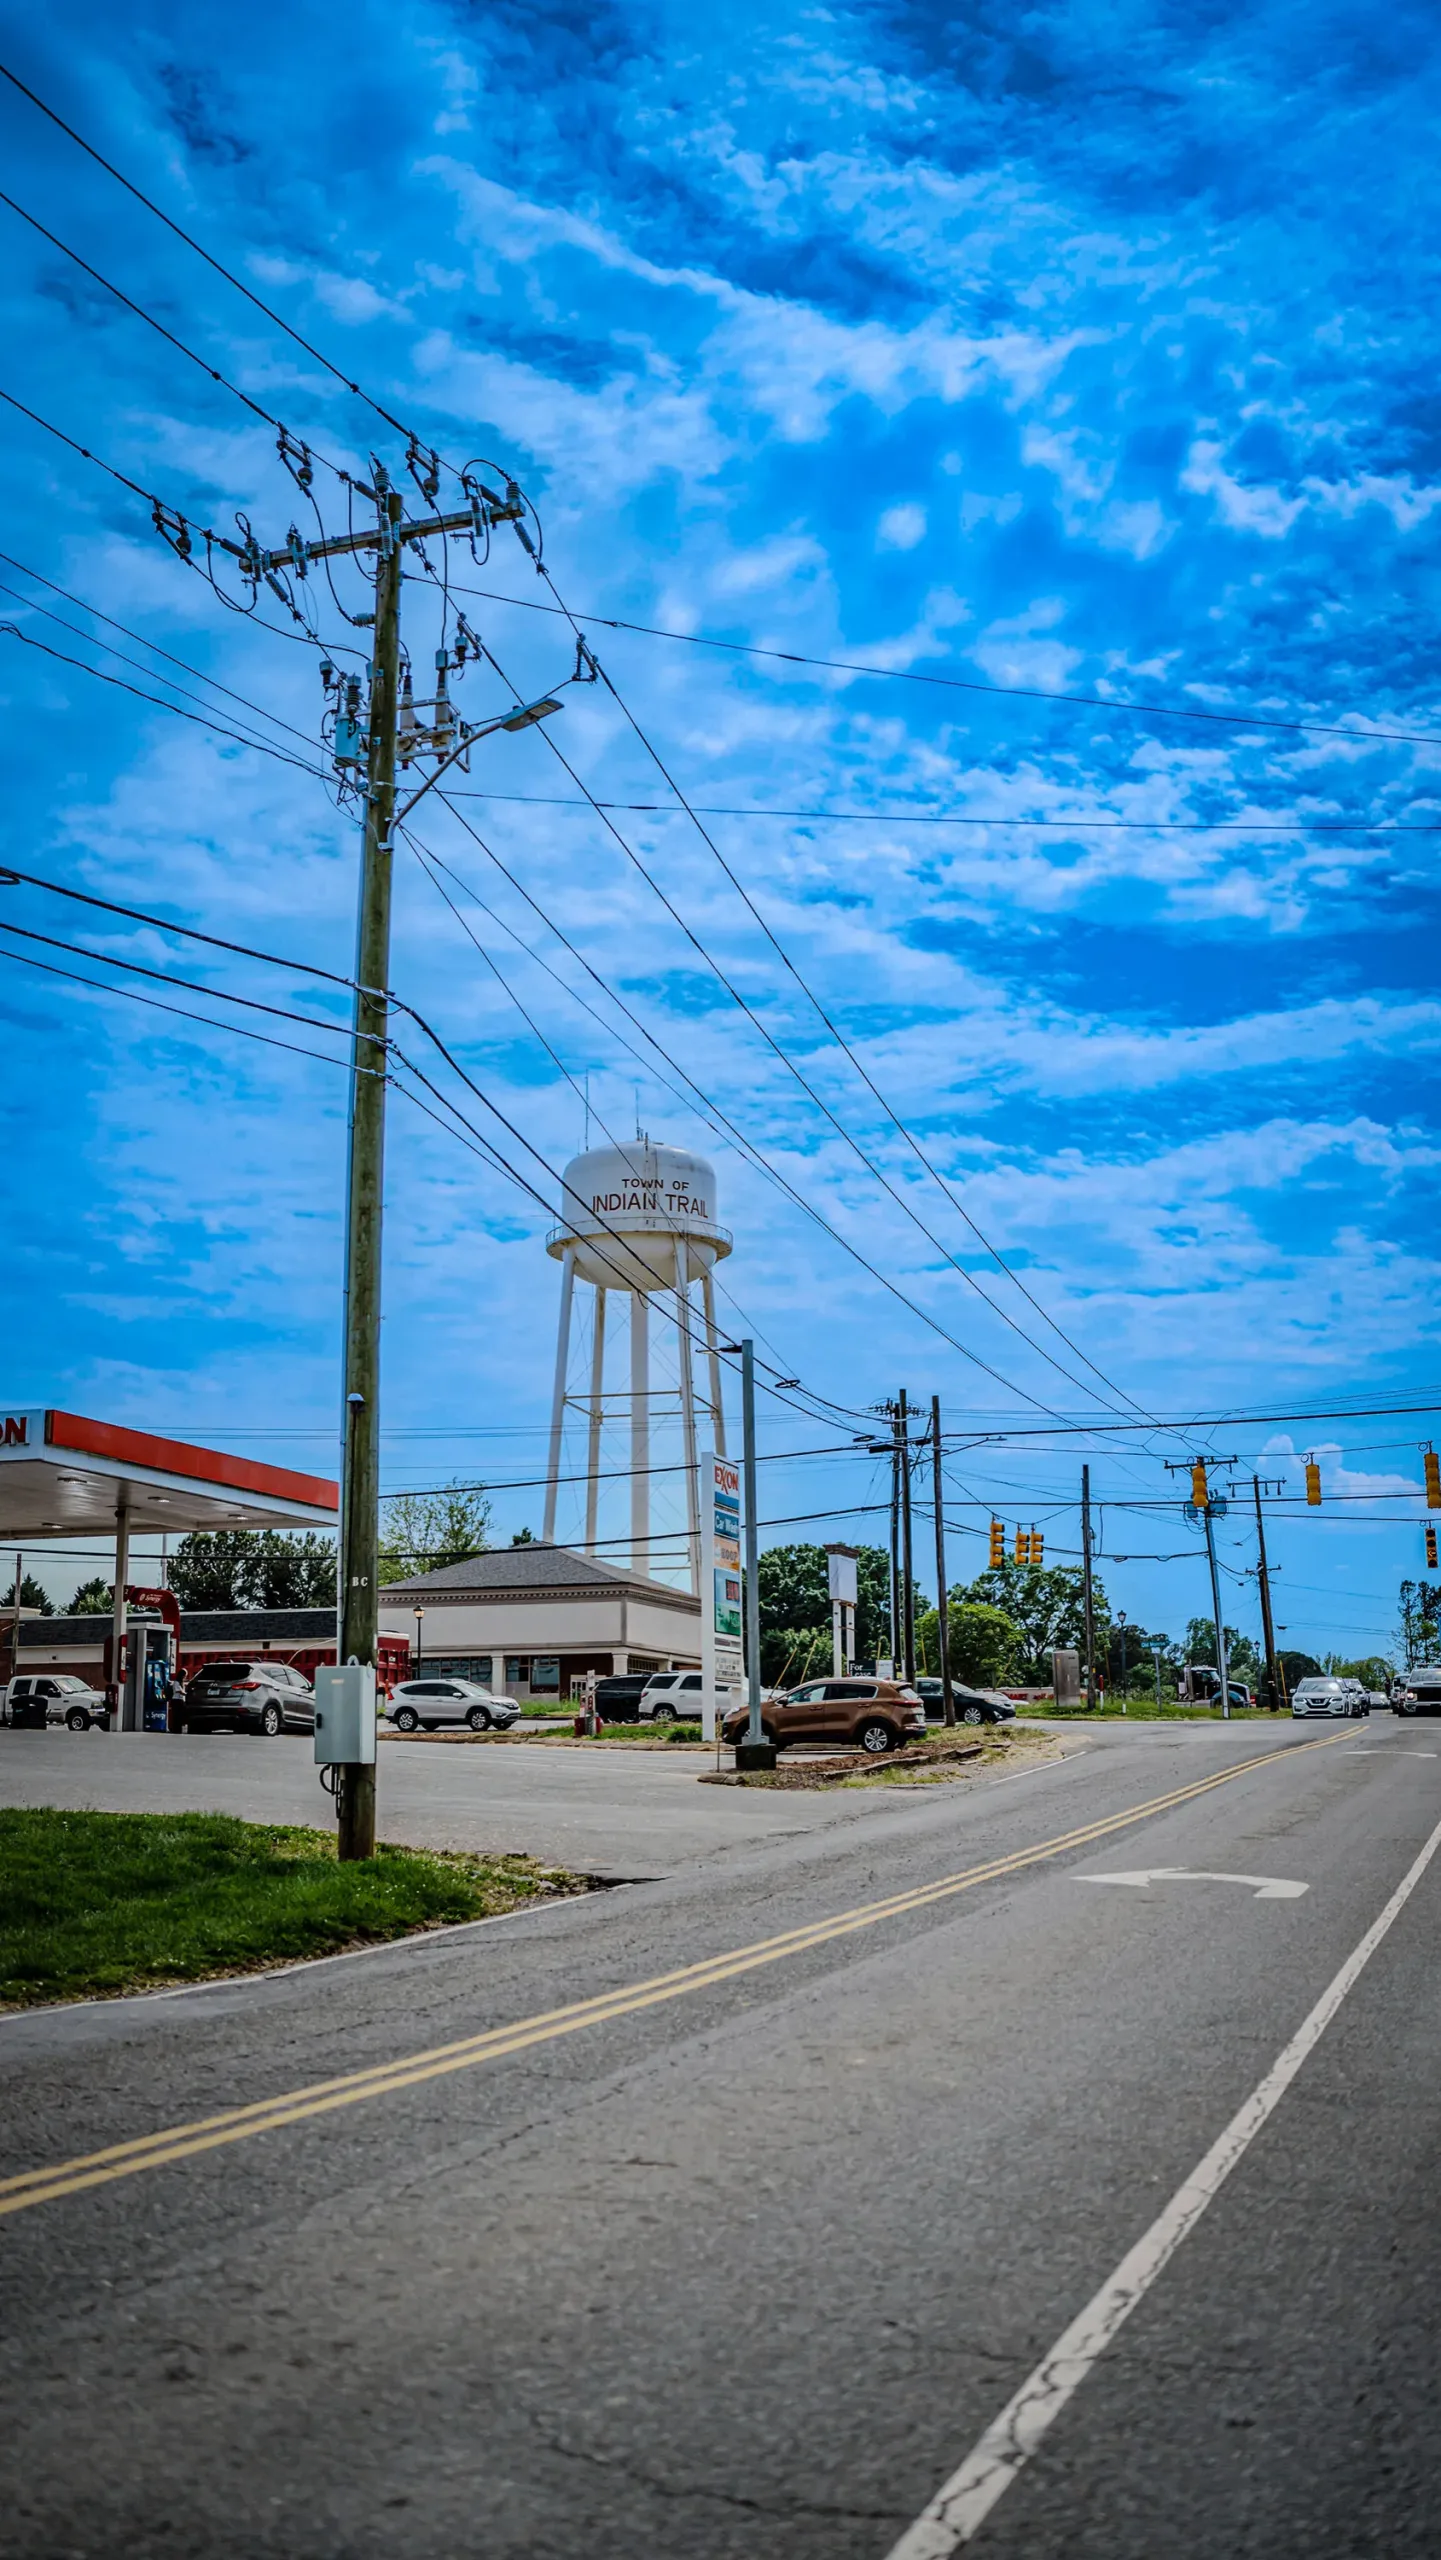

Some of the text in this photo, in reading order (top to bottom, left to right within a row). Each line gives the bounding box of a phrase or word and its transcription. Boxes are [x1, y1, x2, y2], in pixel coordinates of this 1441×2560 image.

[622, 1179, 690, 1191] TOWN OF
[592, 1192, 708, 1219] INDIAN TRAIL
[0, 1416, 27, 1444] N
[714, 1465, 739, 1495] EXXON
[850, 1663, 864, 1671] For
